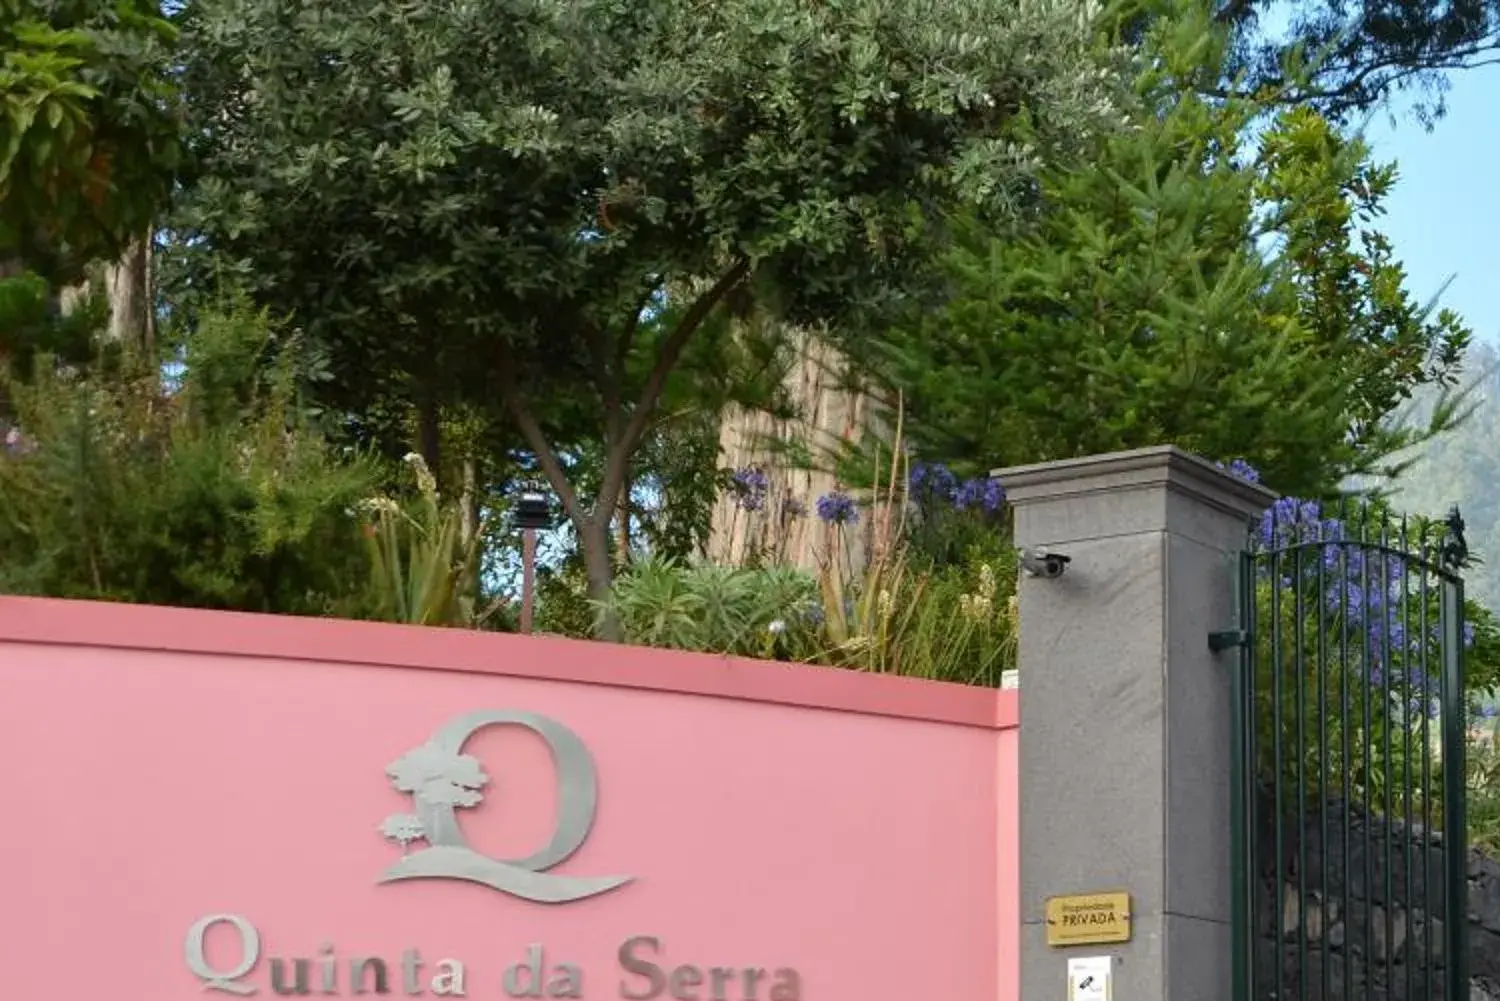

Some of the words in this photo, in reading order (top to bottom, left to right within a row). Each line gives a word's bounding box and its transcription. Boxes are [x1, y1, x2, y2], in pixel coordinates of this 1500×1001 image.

[1063, 911, 1116, 926] PRIVADA
[185, 913, 467, 997] Quinta
[504, 943, 585, 1000] da
